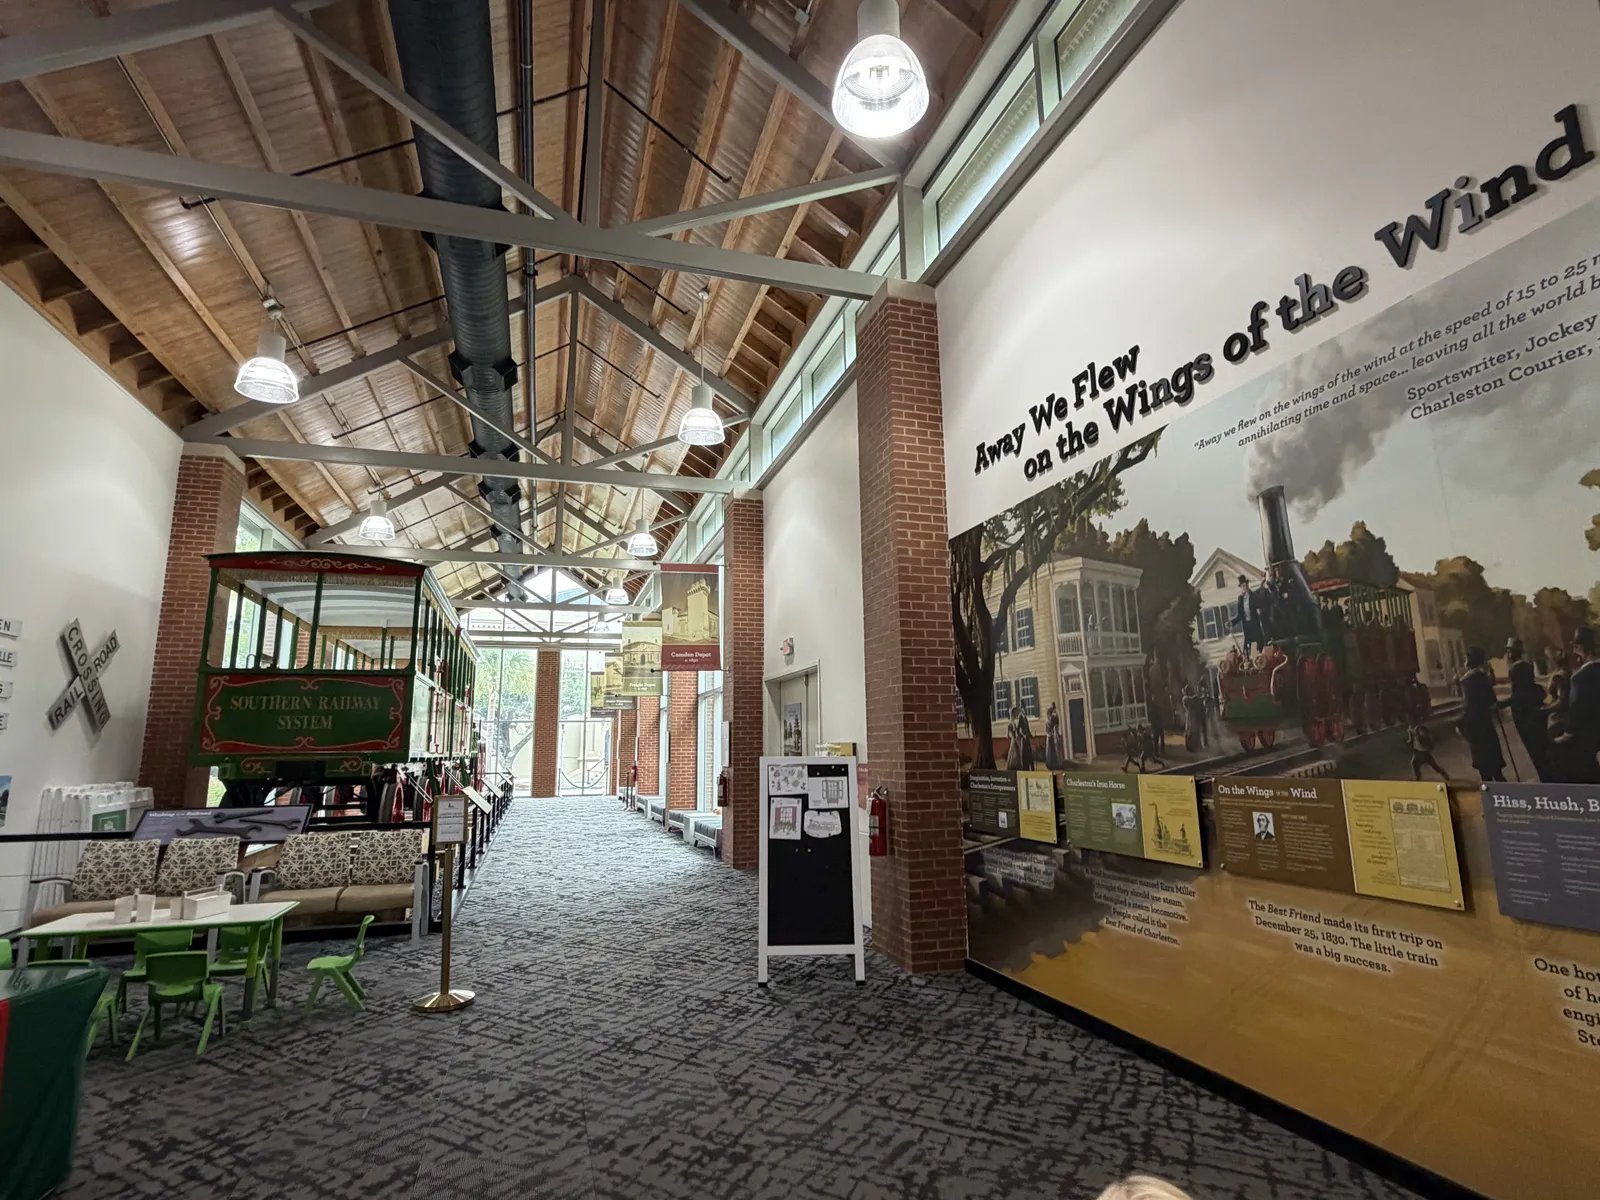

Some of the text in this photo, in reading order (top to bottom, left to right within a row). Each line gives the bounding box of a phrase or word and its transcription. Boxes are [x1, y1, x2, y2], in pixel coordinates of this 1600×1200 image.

[1024, 104, 1594, 479] on the Wings of the Wind
[1224, 426, 1236, 438] we
[1238, 416, 1258, 432] flew
[1259, 410, 1272, 422] on
[1273, 400, 1290, 414] the
[1292, 386, 1324, 406] wings
[1327, 373, 1340, 389] of
[1341, 368, 1361, 384] the
[1363, 346, 1397, 372] wind
[1400, 341, 1416, 356] at
[1418, 330, 1442, 346] the
[1445, 302, 1492, 336] speed
[1496, 290, 1514, 311] of
[1516, 284, 1536, 302] 15
[1540, 275, 1558, 290] to
[1563, 259, 1588, 280] 25
[1238, 412, 1302, 446] annihilating
[1304, 399, 1330, 418] time
[1332, 386, 1356, 406] and
[1412, 336, 1468, 369] leaving
[1472, 322, 1495, 342] all
[1499, 312, 1527, 332] the
[1530, 281, 1586, 316] world
[1407, 314, 1598, 400] Sportswriter, Jockey
[1410, 342, 1593, 420] Charleston Courier,
[974, 344, 1140, 474] Away We Flew
[54, 636, 117, 720] RAIL ROAD
[68, 626, 110, 725] CROSSING
[230, 696, 382, 710] SOUTHERN RAILWAY
[277, 716, 333, 730] SYSTEM
[1109, 781, 1126, 789] Horse
[1218, 785, 1230, 794] On
[1231, 785, 1245, 795] the
[1246, 786, 1274, 798] Wings
[1290, 788, 1317, 799] Wind
[1492, 794, 1532, 811] Hiss,
[1534, 796, 1584, 814] Hush,
[1176, 884, 1196, 897] Miller
[1118, 920, 1136, 933] Friend
[1137, 926, 1143, 934] of
[1249, 900, 1444, 950] The Best Friend made its first trip on
[1255, 916, 1301, 935] December
[1304, 928, 1319, 941] 25,
[1350, 937, 1372, 952] The
[1375, 941, 1403, 958] little
[1406, 950, 1439, 966] train
[1294, 941, 1391, 973] was a big success.
[1534, 958, 1570, 976] One
[1564, 986, 1600, 1004] of h
